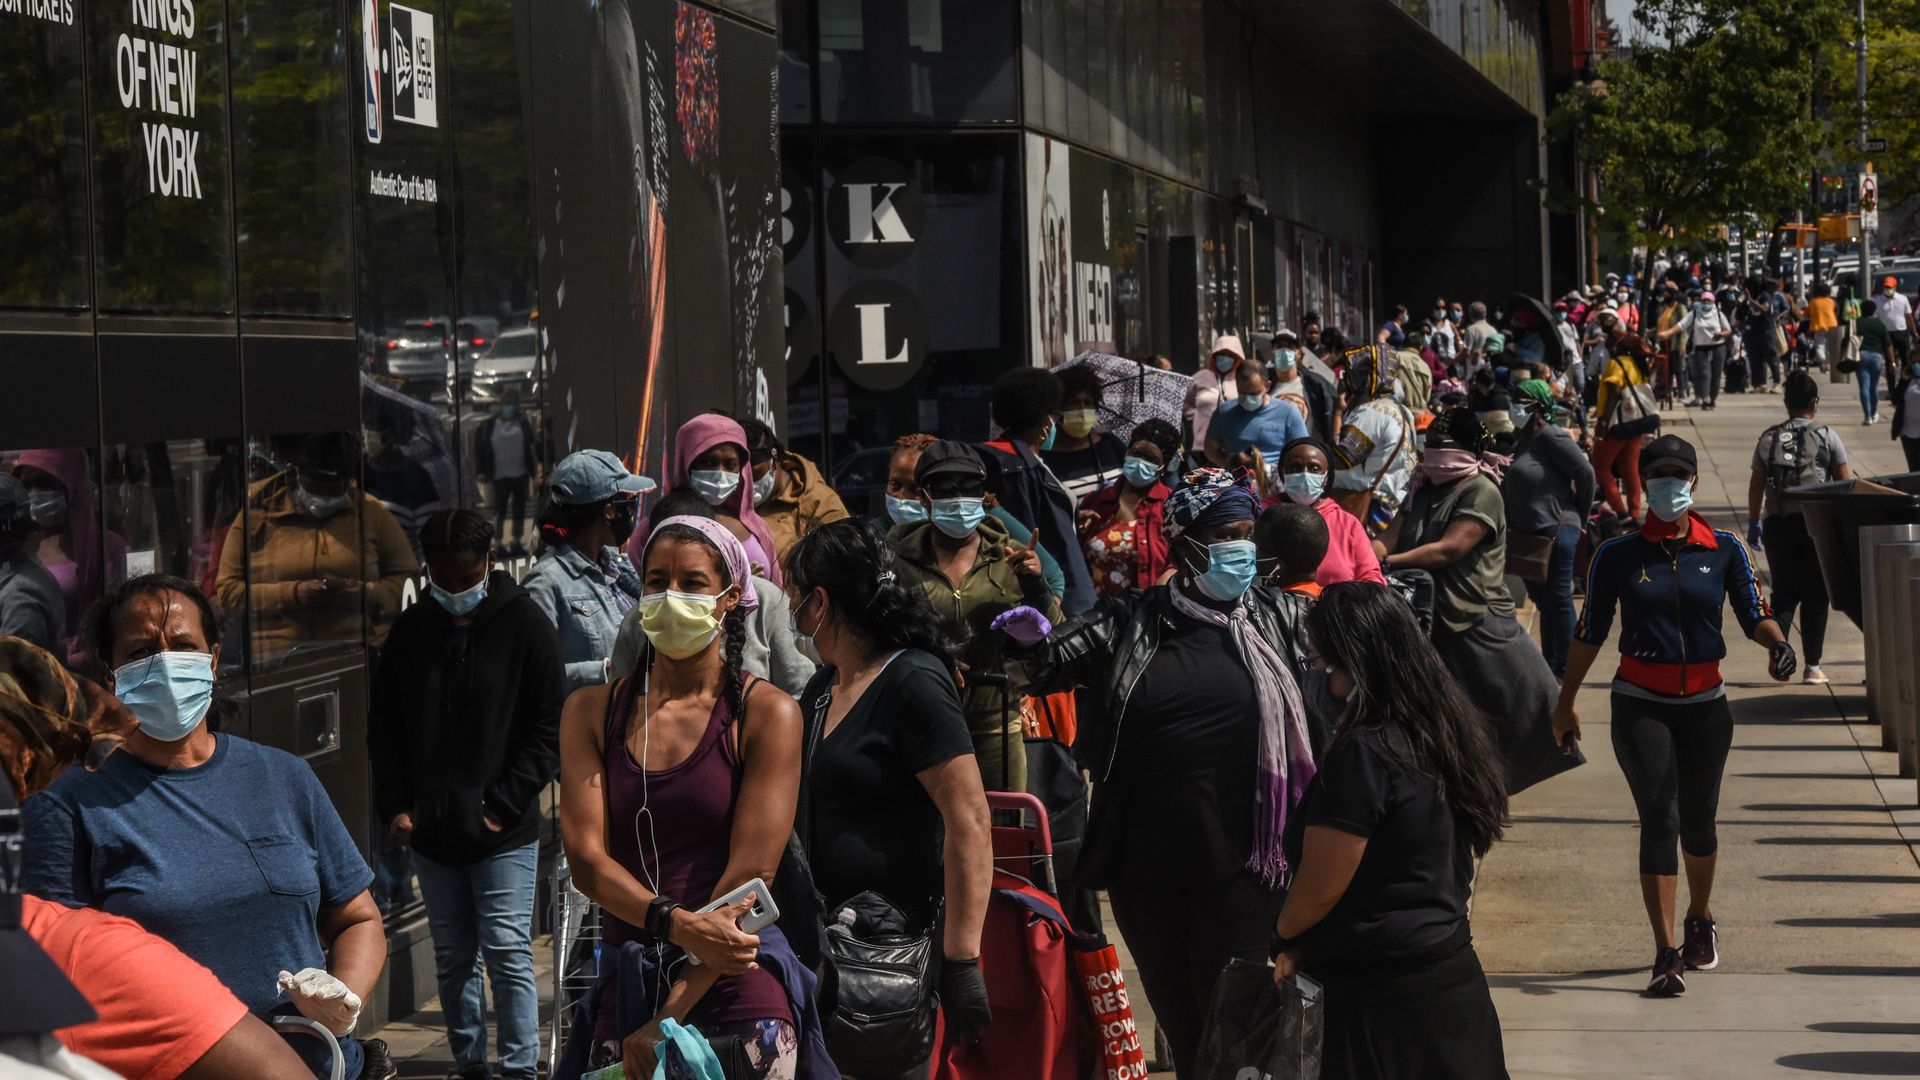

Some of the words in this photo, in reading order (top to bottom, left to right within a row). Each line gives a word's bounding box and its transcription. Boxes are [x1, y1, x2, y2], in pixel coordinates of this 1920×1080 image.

[415, 36, 432, 68] NEW
[116, 33, 147, 109] OF
[149, 41, 197, 118] NEW
[417, 68, 433, 101] ERA
[142, 122, 202, 199] YORK
[370, 170, 397, 197] Authentic
[397, 174, 409, 205] Cap
[409, 175, 415, 200] of
[415, 176, 424, 201] the
[424, 178, 438, 203] NBA
[1091, 988, 1129, 1015] RES
[1107, 1058, 1148, 1080] ROW
